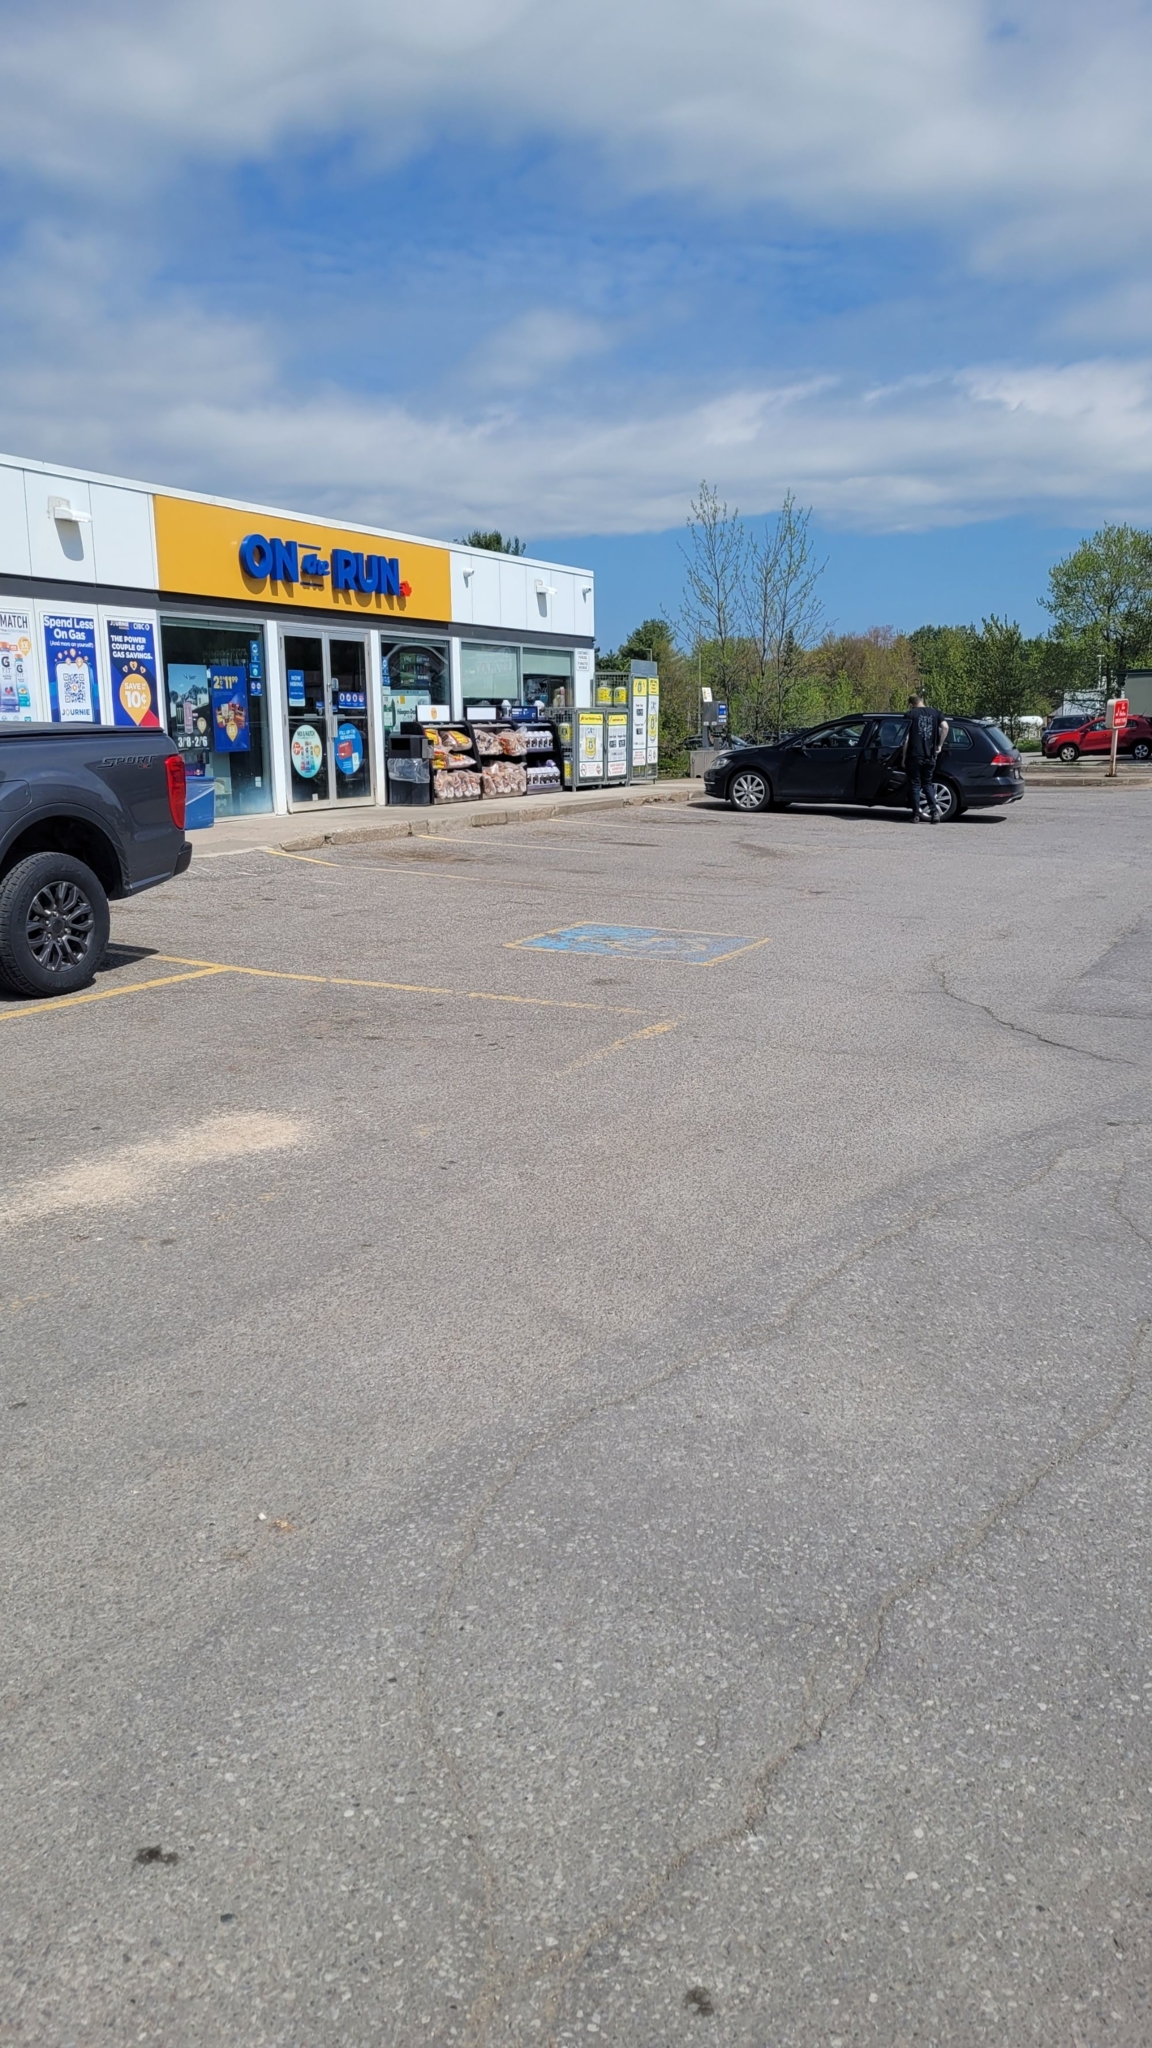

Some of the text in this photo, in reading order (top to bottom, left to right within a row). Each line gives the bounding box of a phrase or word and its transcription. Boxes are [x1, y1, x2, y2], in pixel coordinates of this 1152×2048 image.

[239, 534, 400, 596] ON the RUN
[0, 614, 28, 628] MATCH
[44, 616, 94, 630] Spend Less
[54, 628, 86, 640] On Gas
[214, 676, 220, 689] 2
[125, 690, 147, 708] 10¢
[97, 756, 158, 769] SPORT
